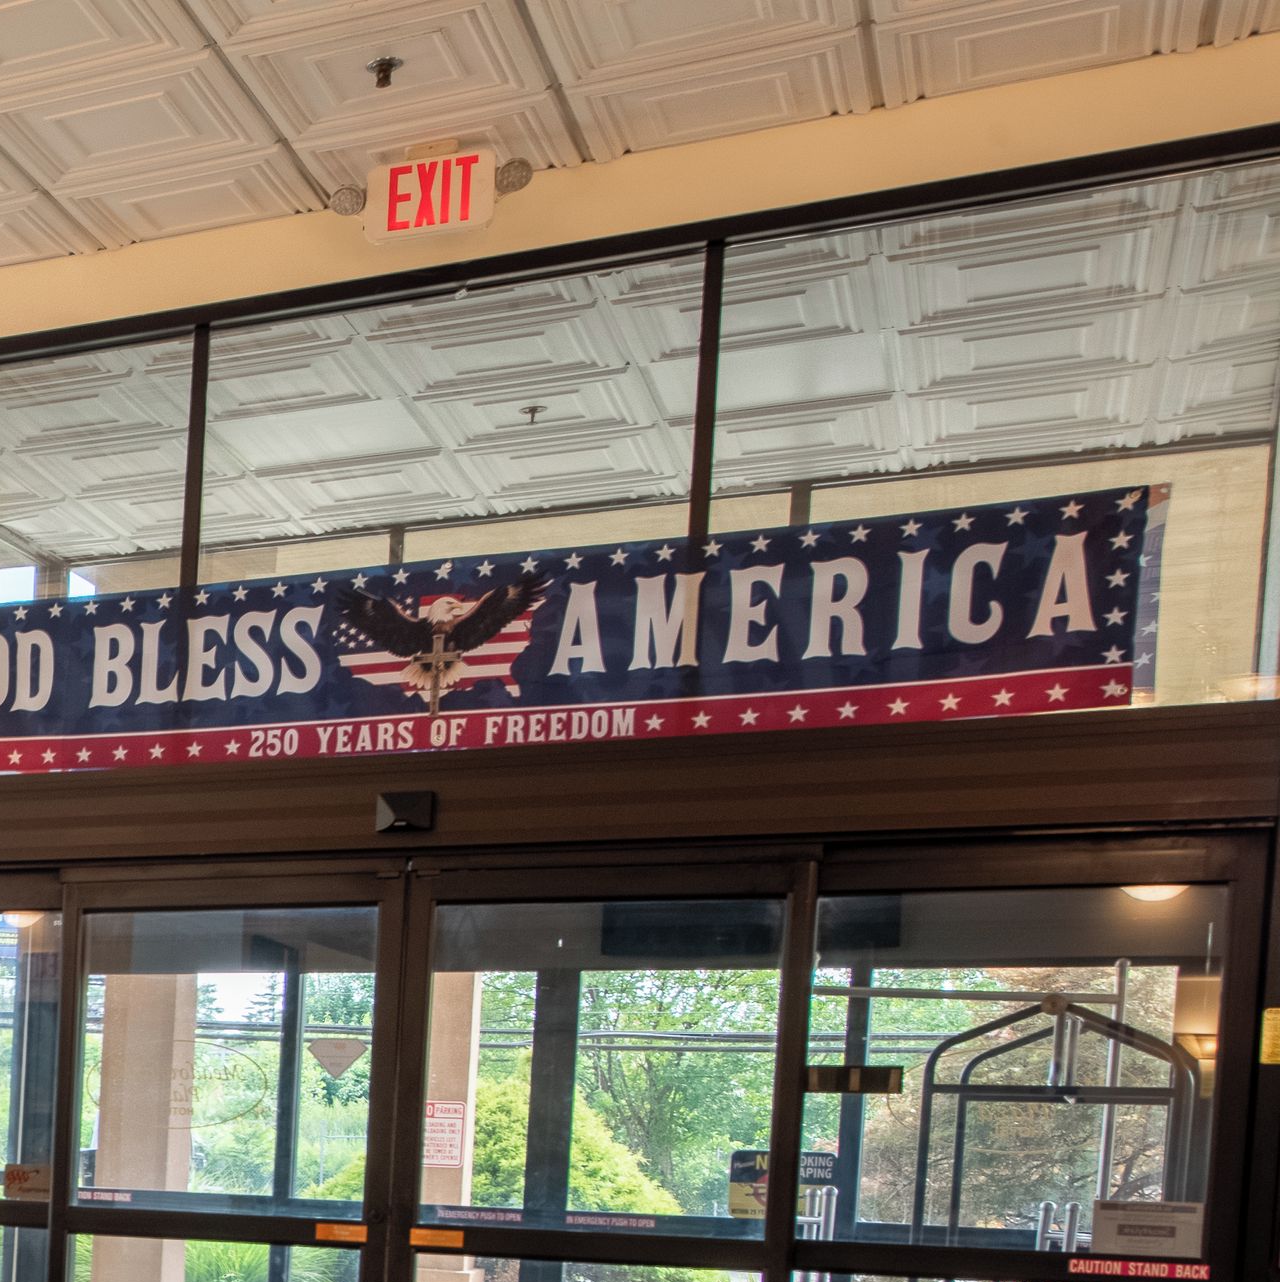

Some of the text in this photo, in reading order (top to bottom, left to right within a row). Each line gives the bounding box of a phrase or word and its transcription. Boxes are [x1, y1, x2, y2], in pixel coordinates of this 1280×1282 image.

[387, 154, 480, 232] EXIT
[89, 605, 327, 708] BLESS
[547, 529, 1097, 677] AMERICA
[248, 706, 637, 758] 250 YEARS OF FREEDOM
[93, 1191, 132, 1202] STAND BACK
[445, 1210, 479, 1220] EMERGENCY
[575, 1216, 609, 1226] EMERGENCY
[1069, 1259, 1210, 1280] CAUTION STAND BACK
